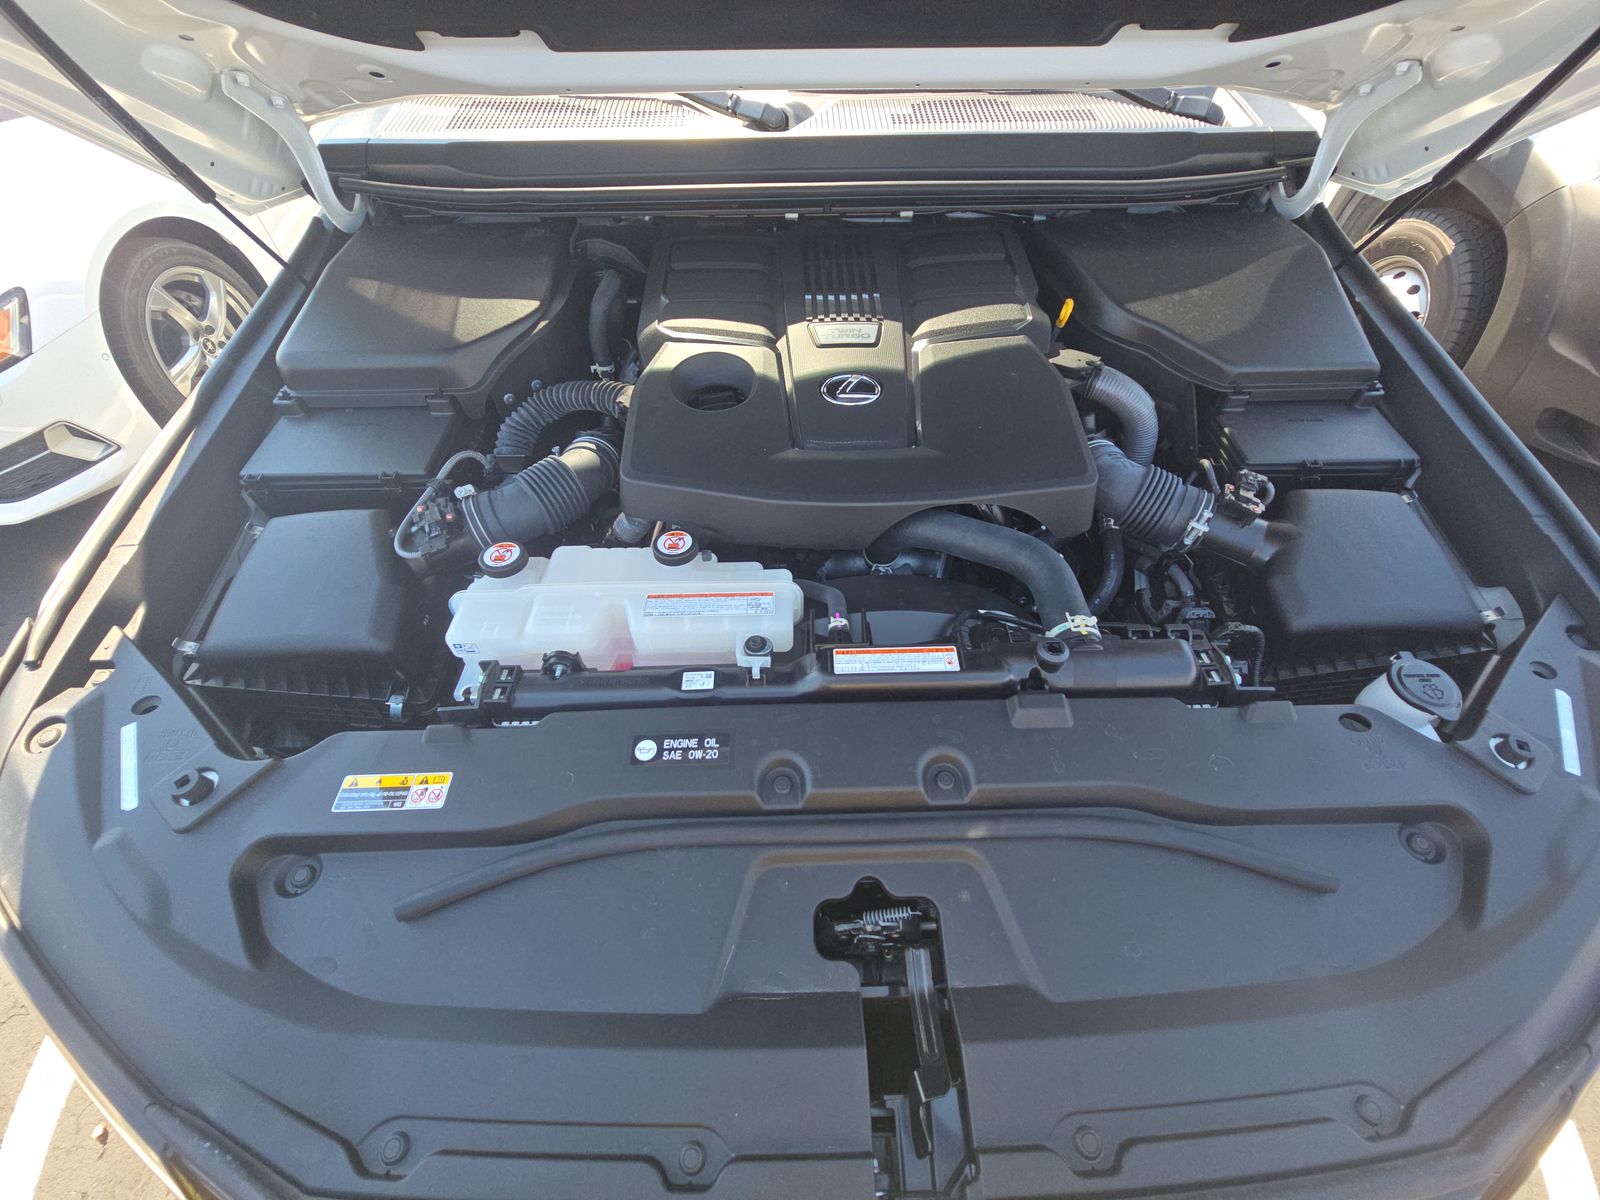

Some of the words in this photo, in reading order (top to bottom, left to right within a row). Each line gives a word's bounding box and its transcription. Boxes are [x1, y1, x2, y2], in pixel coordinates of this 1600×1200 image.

[663, 738, 699, 749] ENGINE
[704, 737, 720, 748] OIL
[662, 750, 682, 761] SAE
[688, 749, 719, 760] 0W-20
